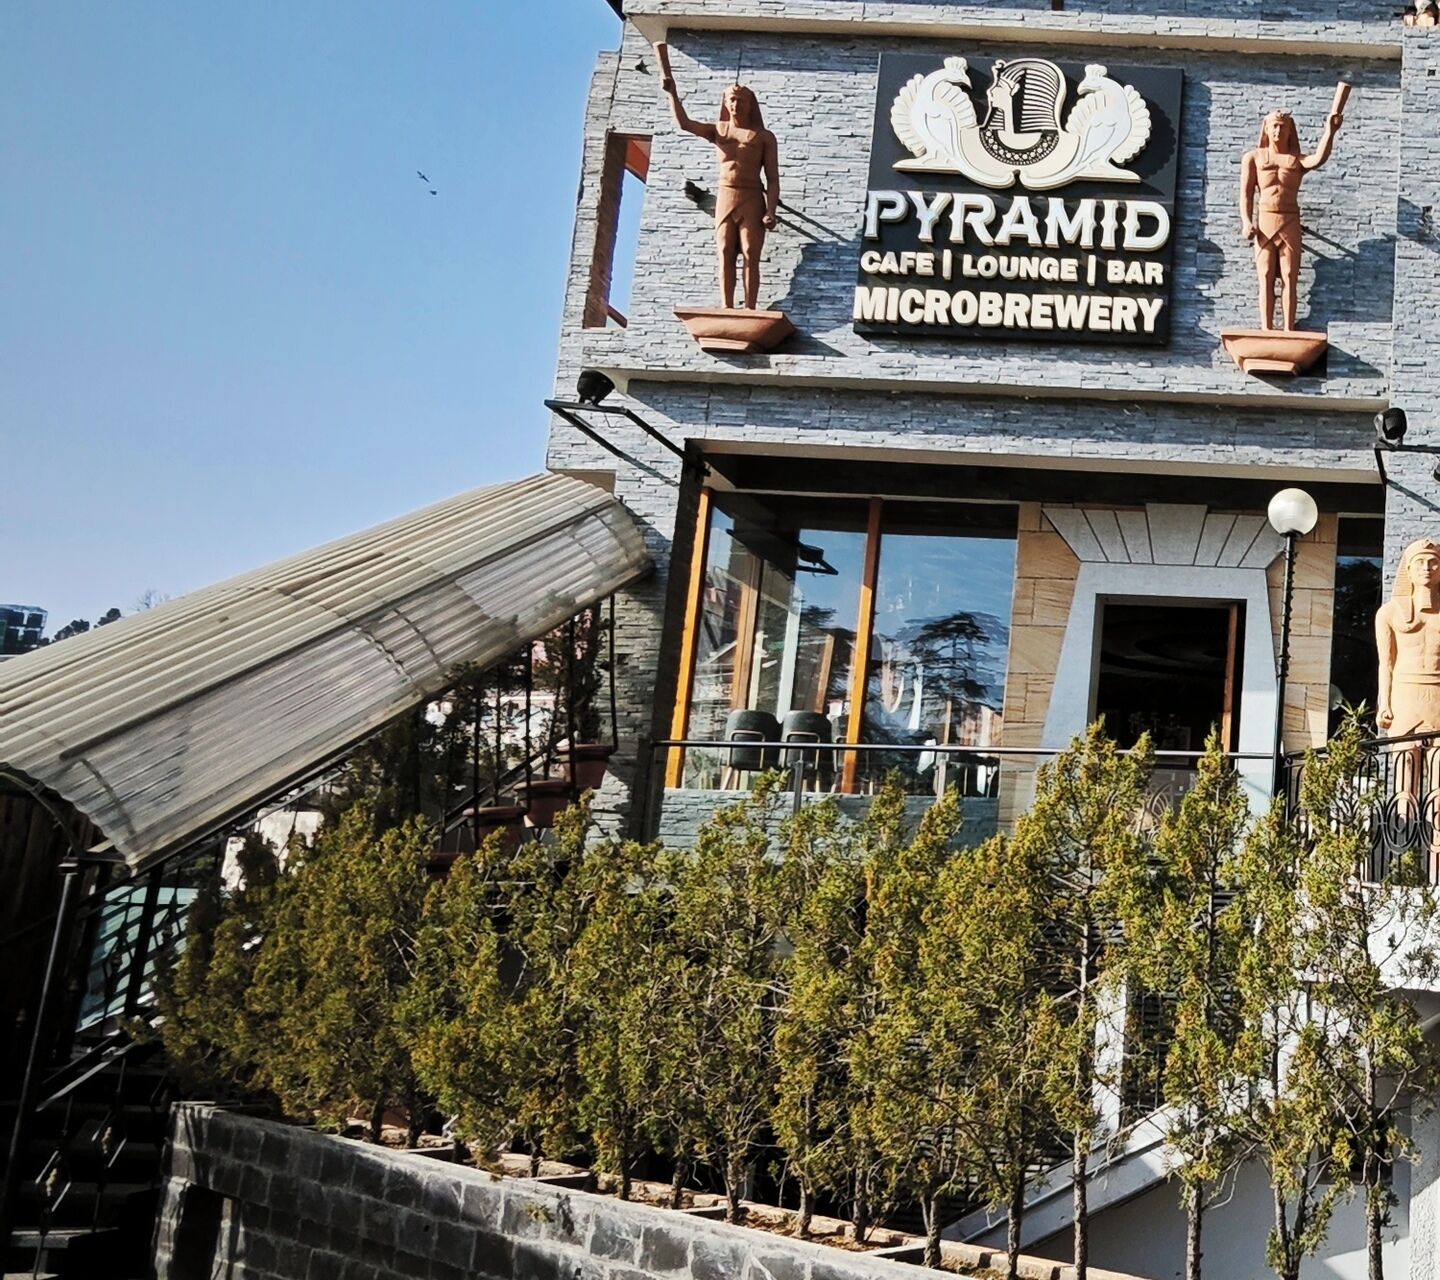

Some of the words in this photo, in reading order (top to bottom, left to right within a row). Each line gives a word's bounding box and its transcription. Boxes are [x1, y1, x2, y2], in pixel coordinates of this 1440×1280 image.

[864, 190, 1170, 251] PYRAMID
[860, 251, 934, 274] CAFE
[962, 254, 1078, 282] LOUNGE
[1107, 260, 1164, 285] BAR
[853, 286, 1163, 333] MICROBREWERY
